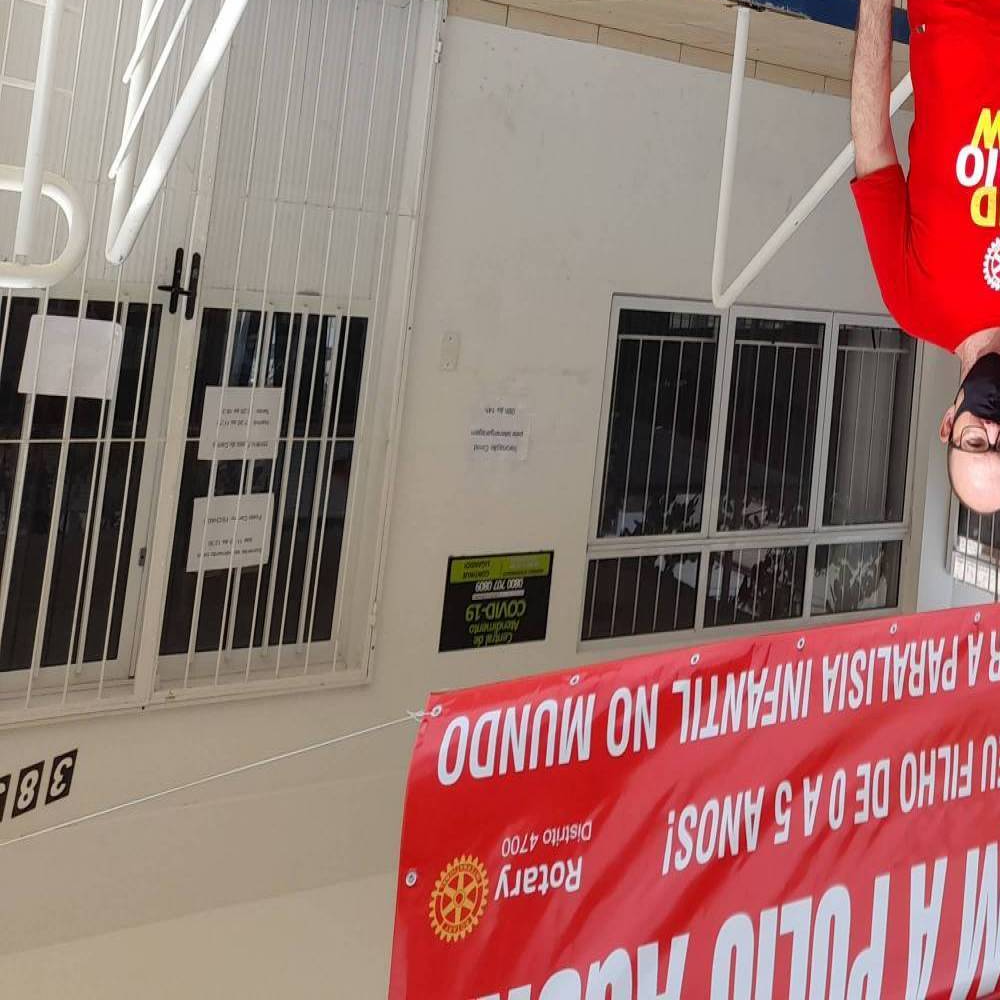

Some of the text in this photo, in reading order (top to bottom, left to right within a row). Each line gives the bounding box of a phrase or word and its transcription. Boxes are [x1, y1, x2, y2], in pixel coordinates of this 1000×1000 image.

[464, 599, 527, 622] COVID-19
[506, 578, 524, 590] 0800
[468, 619, 519, 635] Atendimento
[472, 631, 513, 648] Central de
[967, 631, 984, 688] A
[671, 659, 813, 744] INFANTIL
[822, 634, 959, 714] PARALISIA
[437, 693, 596, 786] MUNDO
[606, 682, 660, 757] NO
[0, 756, 73, 812] 38
[802, 772, 823, 838] A
[854, 758, 890, 825] DE
[899, 739, 974, 814] FILHO
[501, 820, 592, 857] Distrito 4700
[661, 785, 765, 876] ANOS!
[774, 779, 793, 845] 5
[494, 856, 583, 901] Rotary
[905, 856, 948, 1000] A
